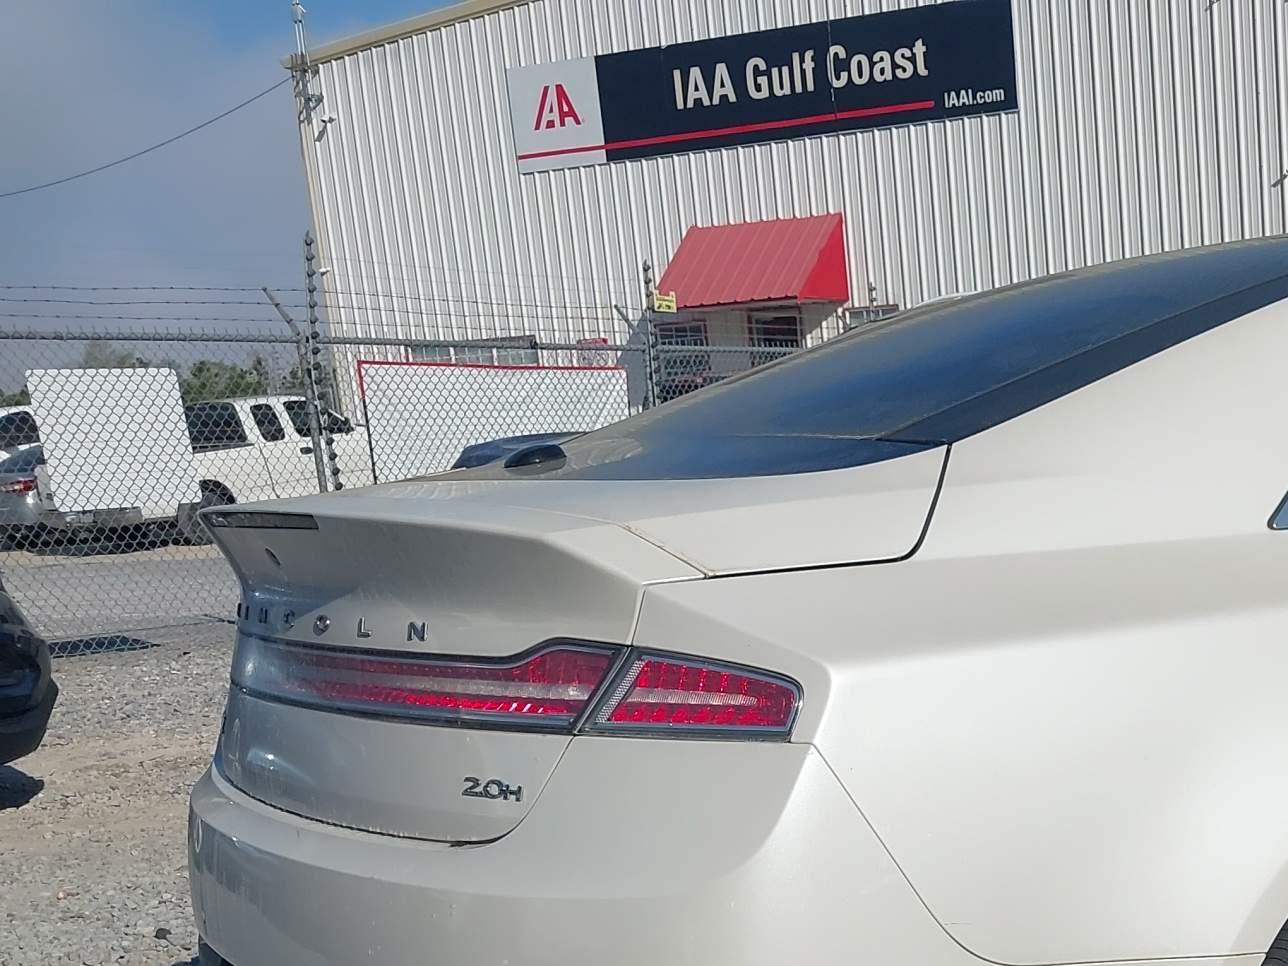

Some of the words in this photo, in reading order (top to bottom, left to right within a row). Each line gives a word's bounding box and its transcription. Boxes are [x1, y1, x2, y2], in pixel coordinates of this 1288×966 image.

[672, 62, 737, 110] IAA
[745, 49, 816, 100] Gulf
[826, 38, 929, 88] Coast
[943, 89, 1005, 108] IAAI.com
